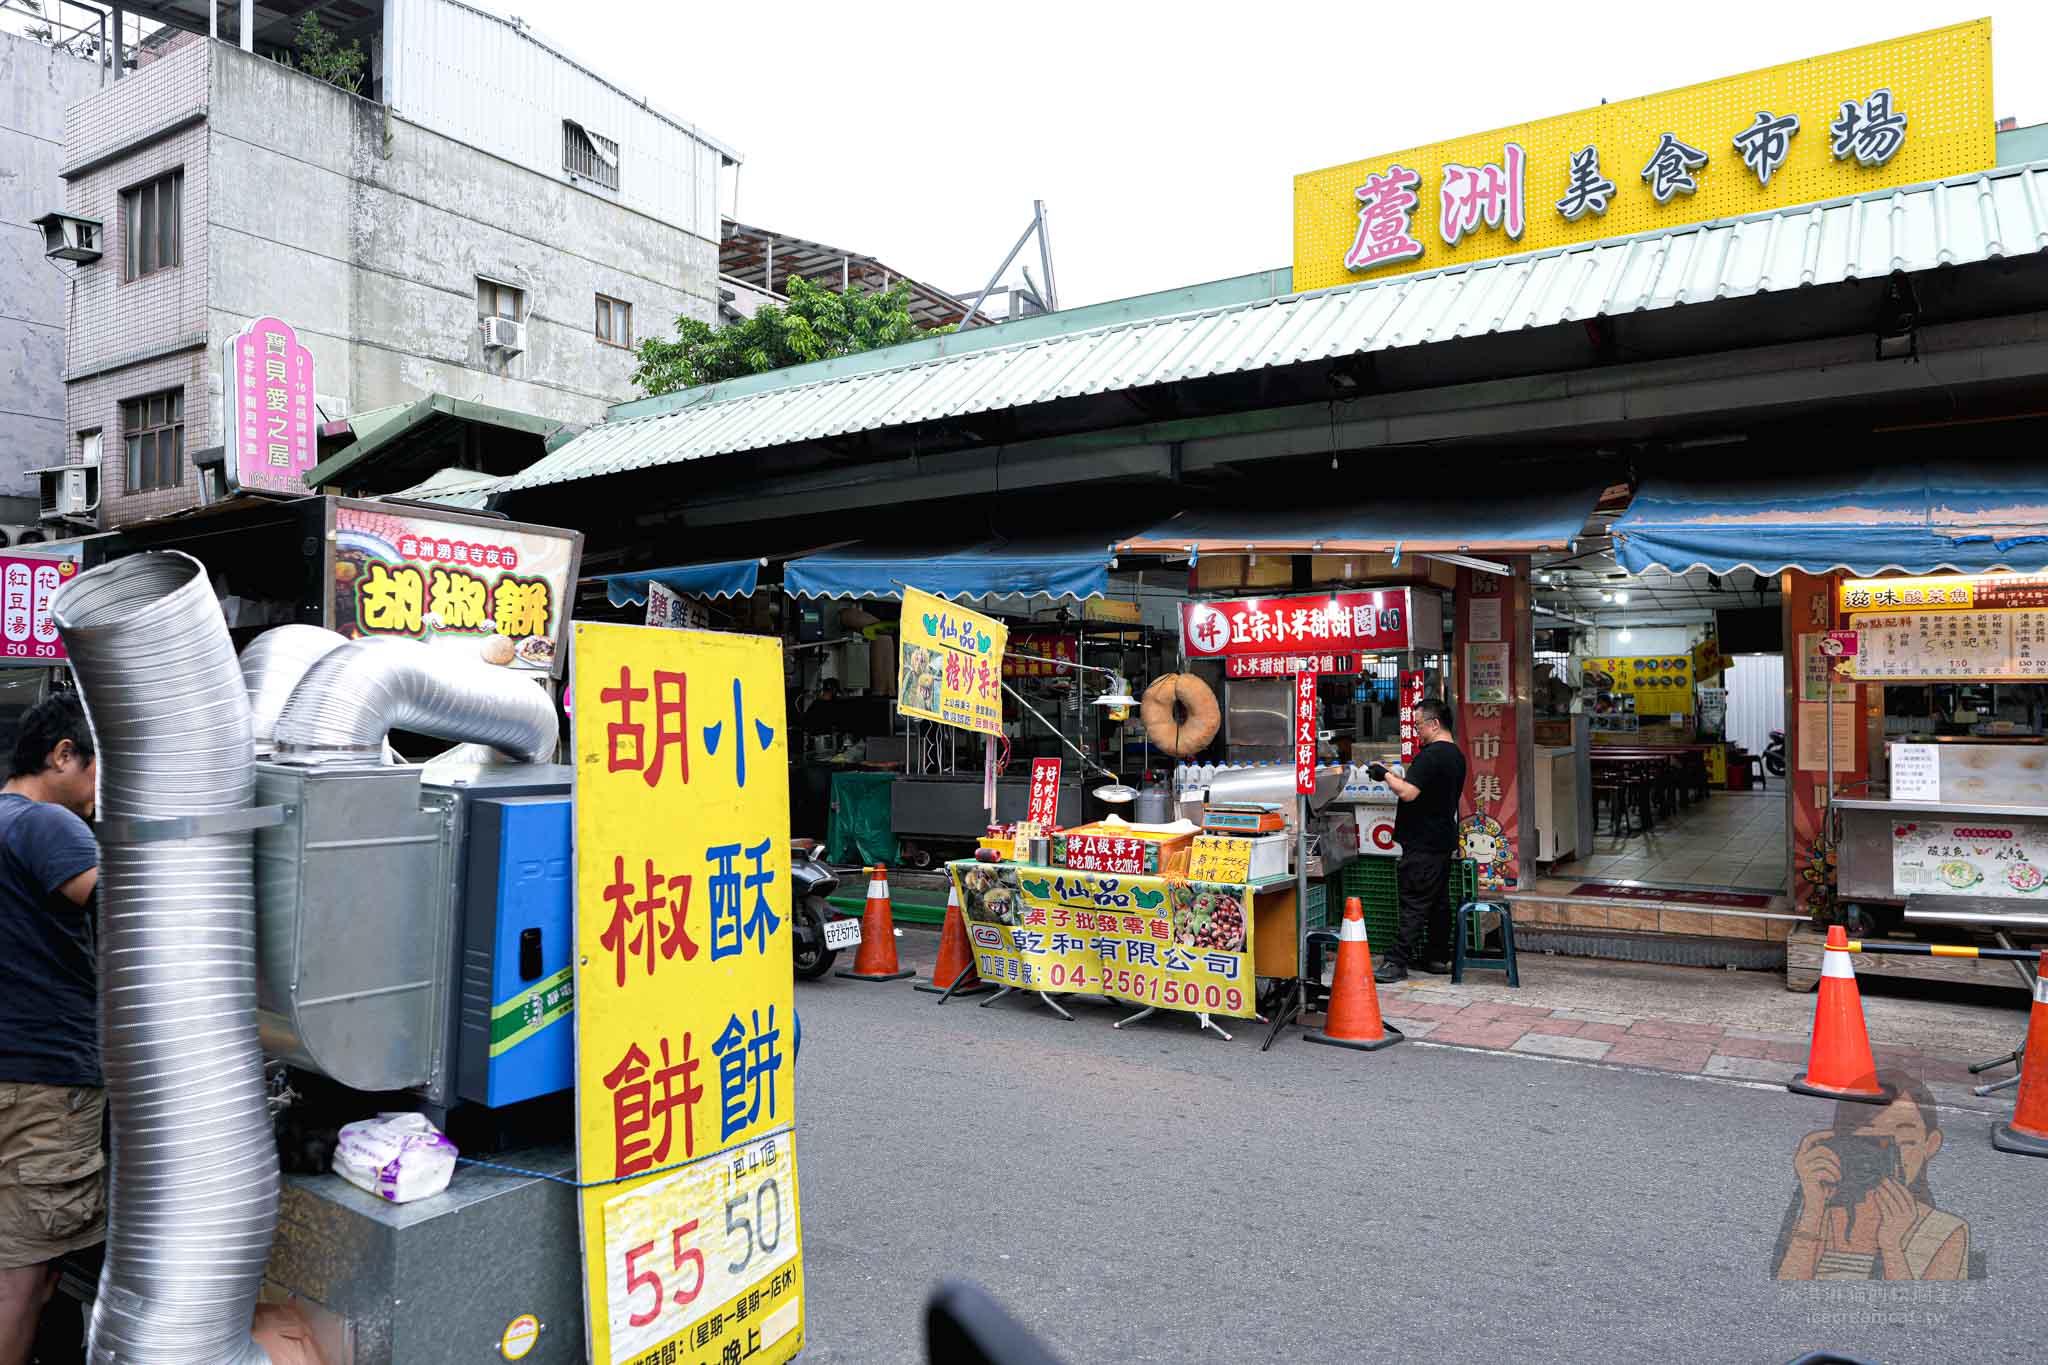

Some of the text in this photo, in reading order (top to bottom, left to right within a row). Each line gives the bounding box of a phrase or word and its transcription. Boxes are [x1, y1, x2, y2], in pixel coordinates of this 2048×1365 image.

[1346, 89, 1908, 274] 蘆洲美食市場
[264, 332, 290, 468] 寶貝愛之屋
[402, 539, 516, 566] 蘆洲湧蓮寺夜市
[8, 569, 28, 634] 紅豆湯
[38, 571, 57, 635] 花生湯
[362, 566, 549, 637] 胡椒餅
[1845, 587, 1969, 608] 滋味酸菜魚
[939, 613, 976, 650] 仙品
[1232, 605, 1377, 643] 正宗小米甜甜圈
[7, 644, 27, 655] 50
[36, 645, 56, 656] 50
[1068, 835, 1141, 858] 特A級栗子
[703, 677, 783, 1143] 小酥餅
[1055, 876, 1129, 907] 仙品
[601, 664, 704, 1185] 胡椒餅
[1025, 908, 1170, 940] 栗子批發零售
[1012, 930, 1240, 980] 乾和有限公司
[1050, 963, 1243, 1011] 04-25615009
[726, 1178, 781, 1275] 50
[625, 1218, 705, 1327] 55
